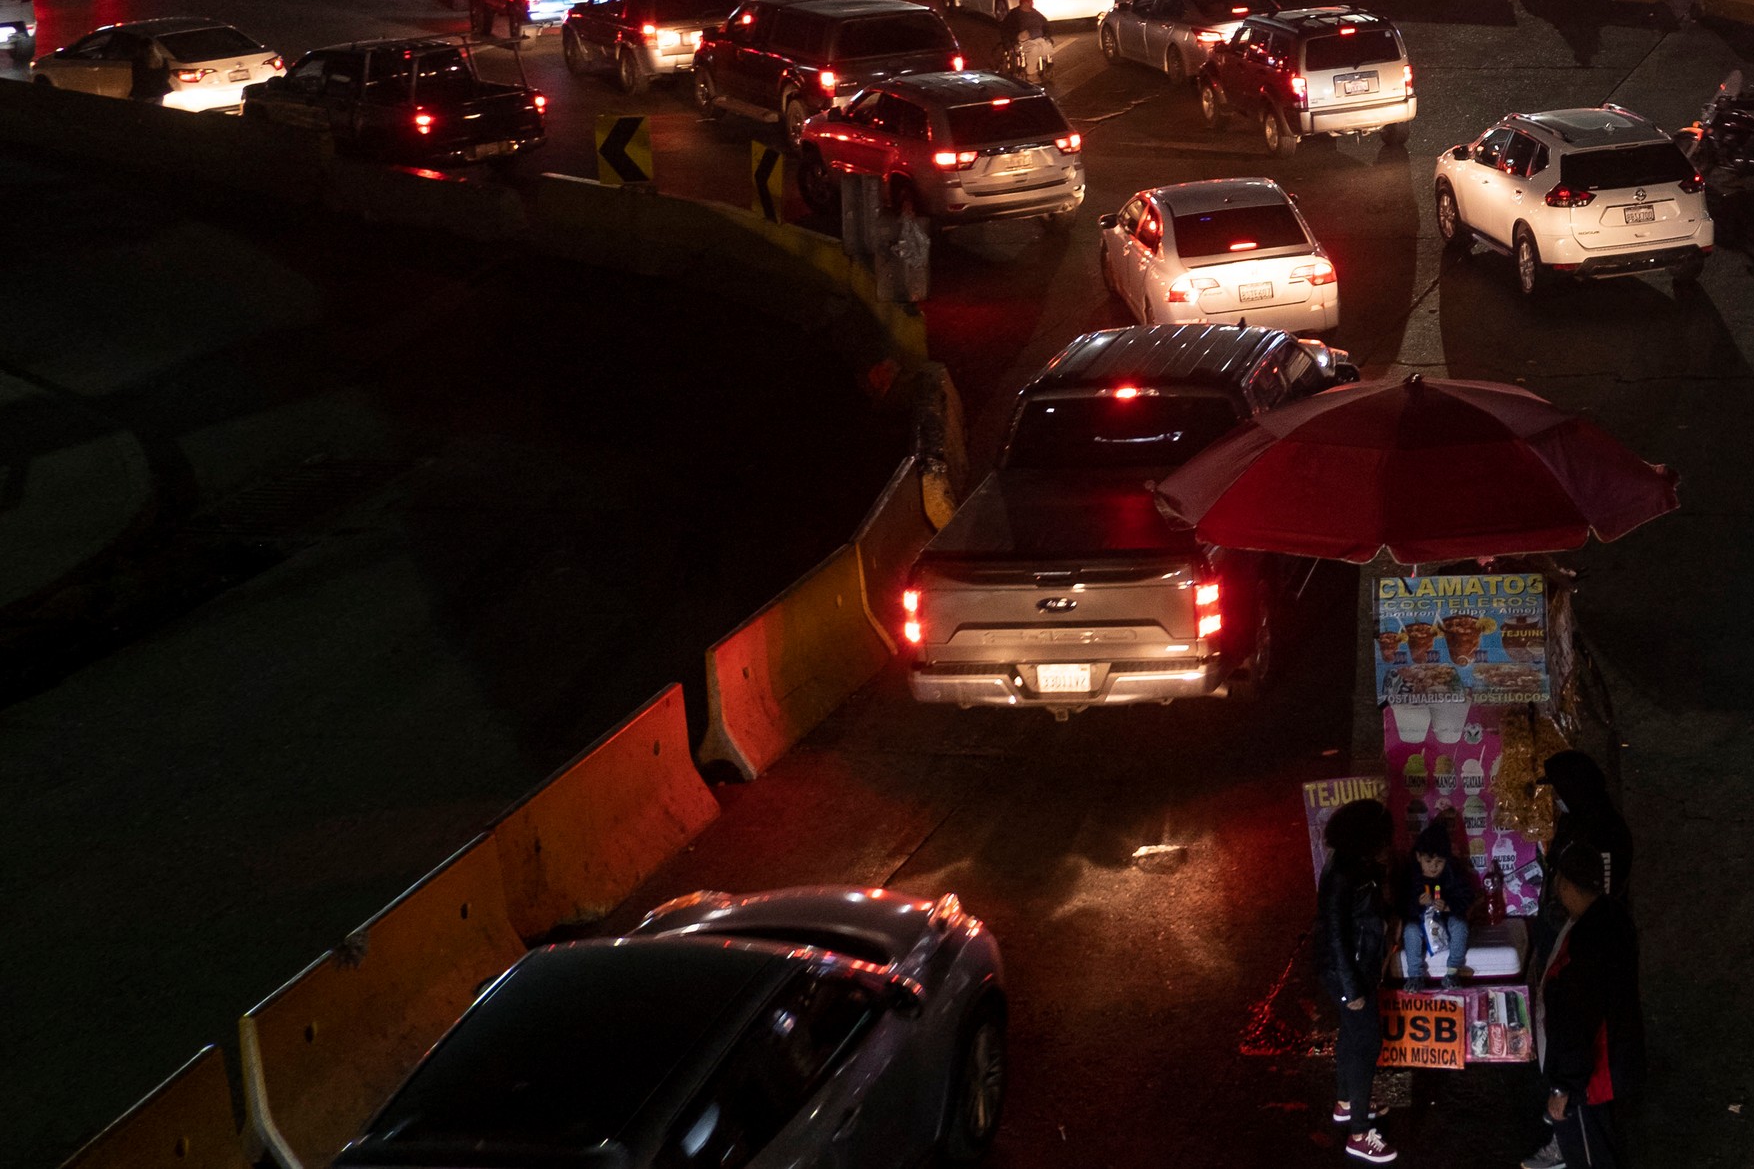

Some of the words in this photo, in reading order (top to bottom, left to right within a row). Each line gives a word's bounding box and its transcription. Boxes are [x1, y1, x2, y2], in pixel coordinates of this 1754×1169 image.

[1379, 574, 1543, 599] CLAMATOS
[1383, 596, 1538, 610] COCTELEROS
[1472, 692, 1550, 703] TOSTILOCOS
[1434, 776, 1457, 789] MANGO
[1383, 998, 1457, 1012] MEMORIAS
[1383, 1015, 1458, 1042] USB
[1382, 1046, 1407, 1063] CON
